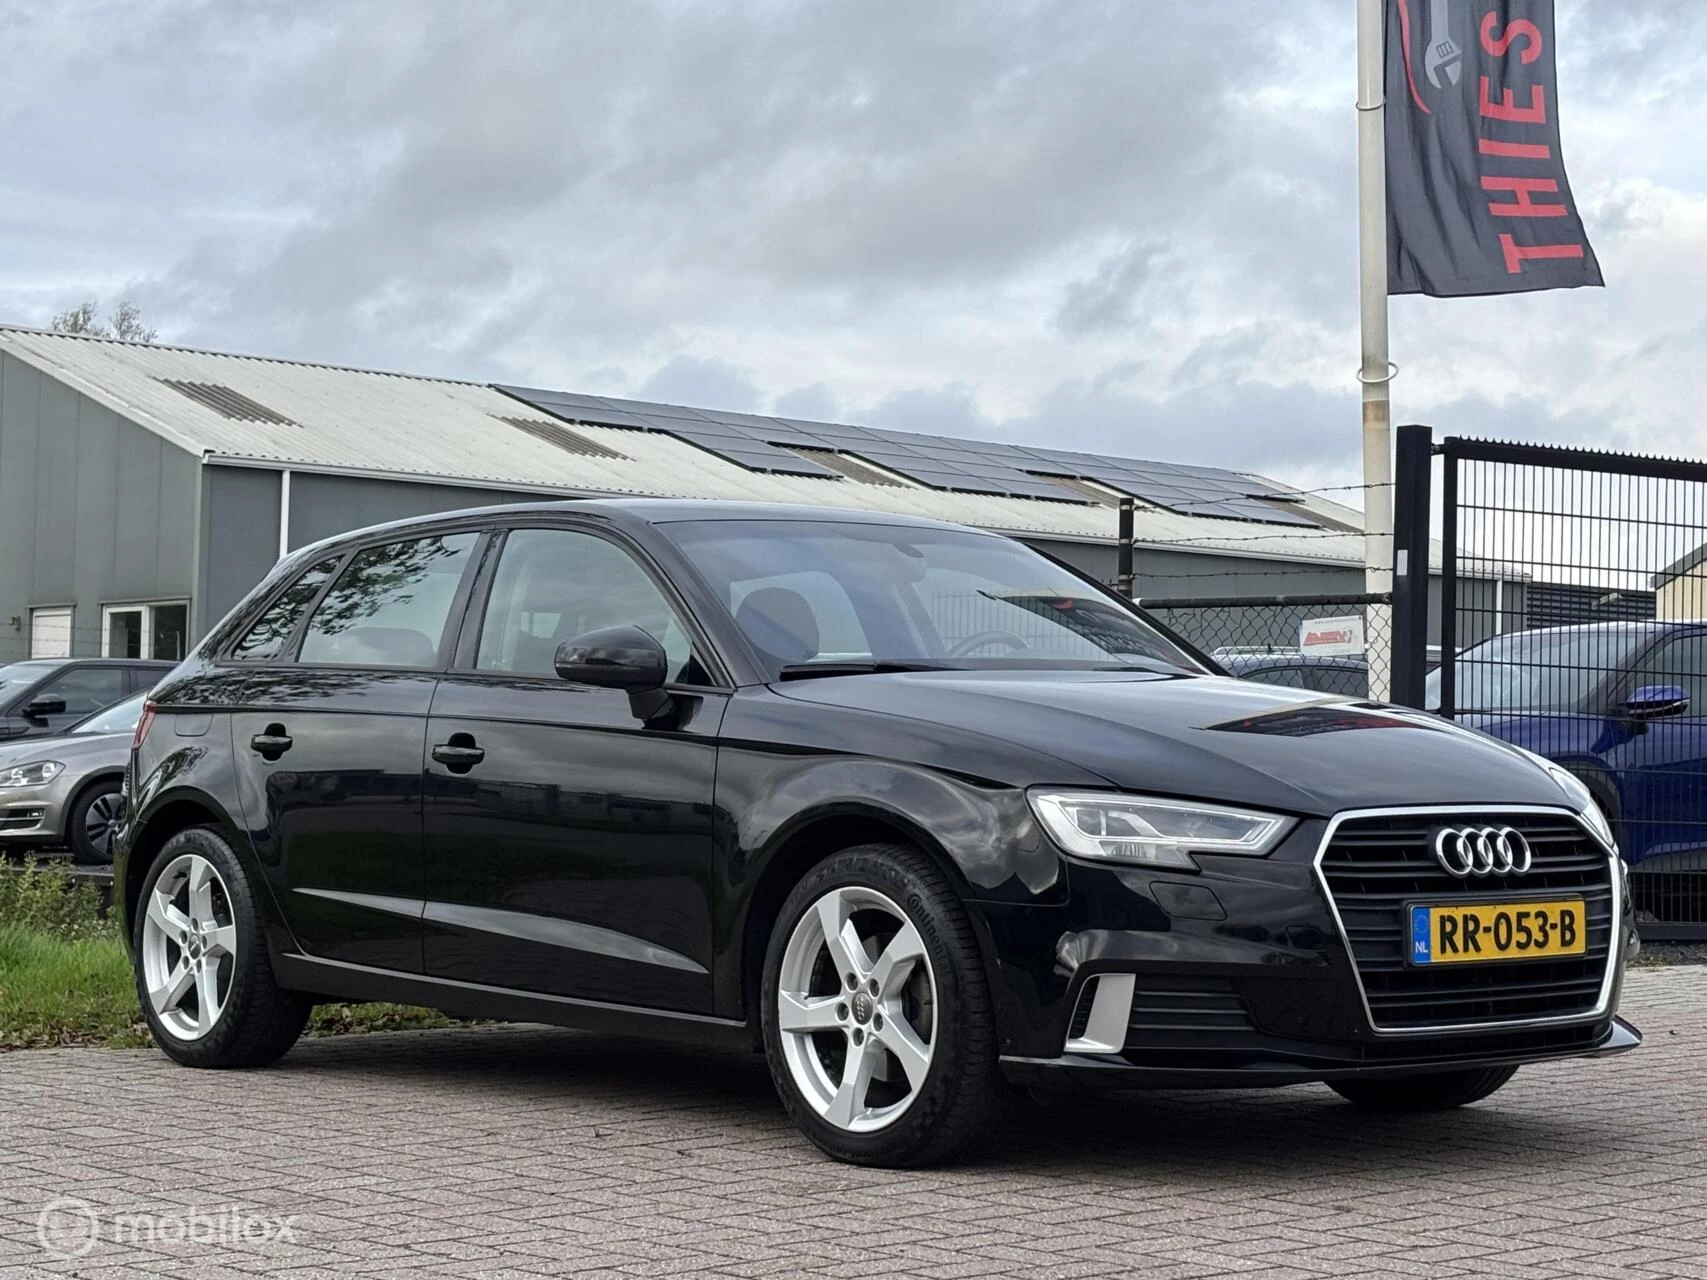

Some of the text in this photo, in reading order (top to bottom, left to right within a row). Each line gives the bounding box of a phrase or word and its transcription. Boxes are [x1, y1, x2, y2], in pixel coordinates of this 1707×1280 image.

[1478, 10, 1584, 274] THIES
[1414, 941, 1429, 954] NL
[1438, 909, 1577, 954] RR-053-B
